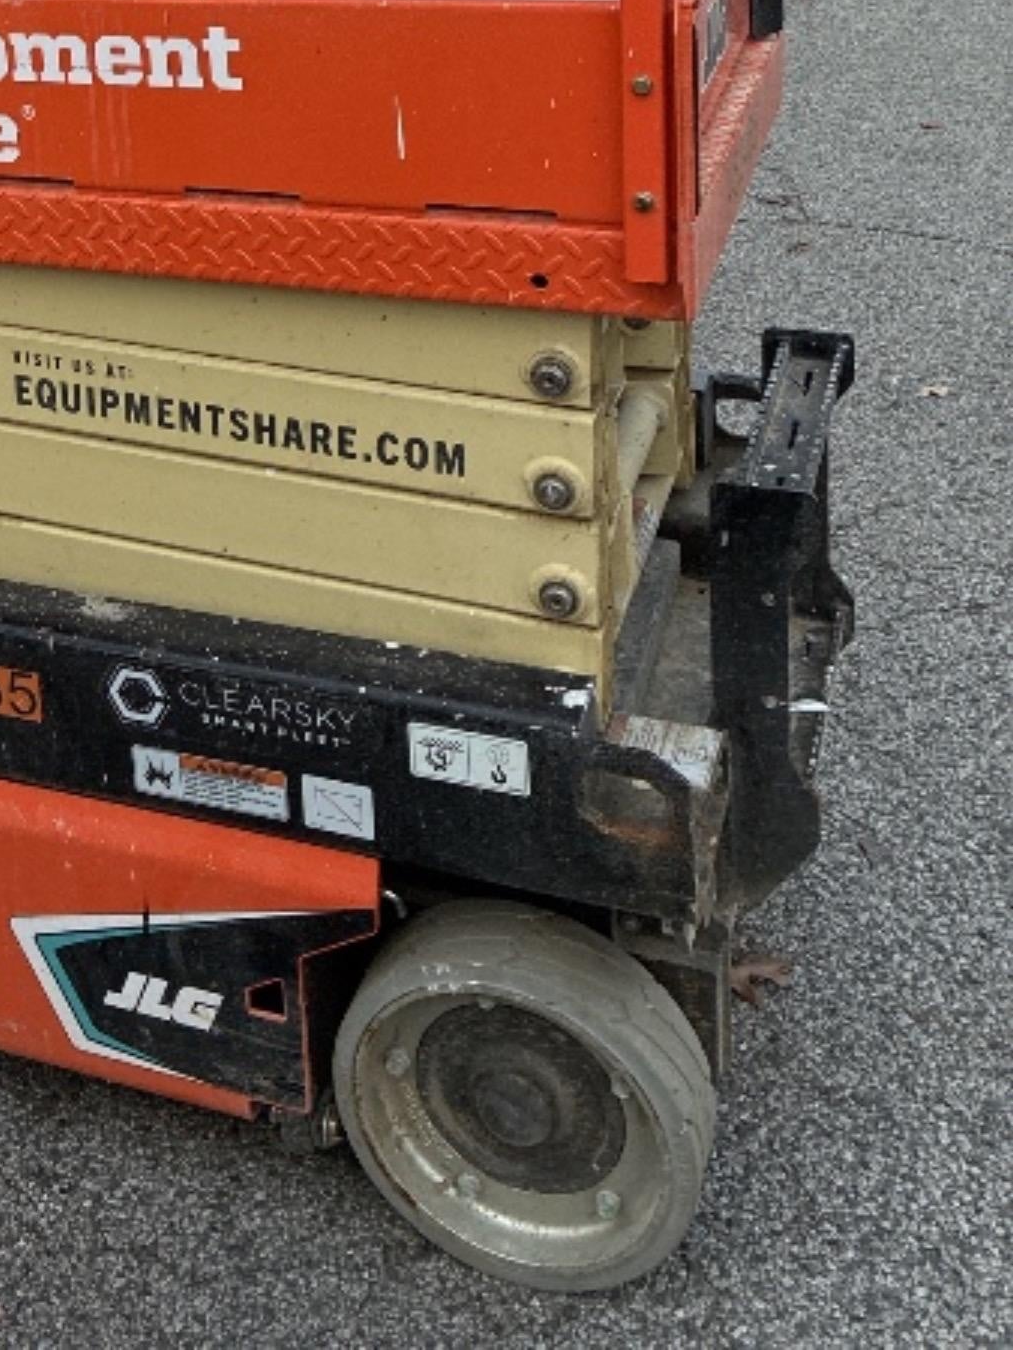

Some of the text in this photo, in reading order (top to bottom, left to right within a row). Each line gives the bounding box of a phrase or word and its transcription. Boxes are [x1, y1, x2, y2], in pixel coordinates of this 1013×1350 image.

[13, 350, 63, 371] VISIT
[71, 358, 96, 376] US
[14, 374, 467, 478] EQUIPMENTSHARE.COM
[178, 681, 357, 732] CLEARSKY
[103, 971, 225, 1032] JLG
